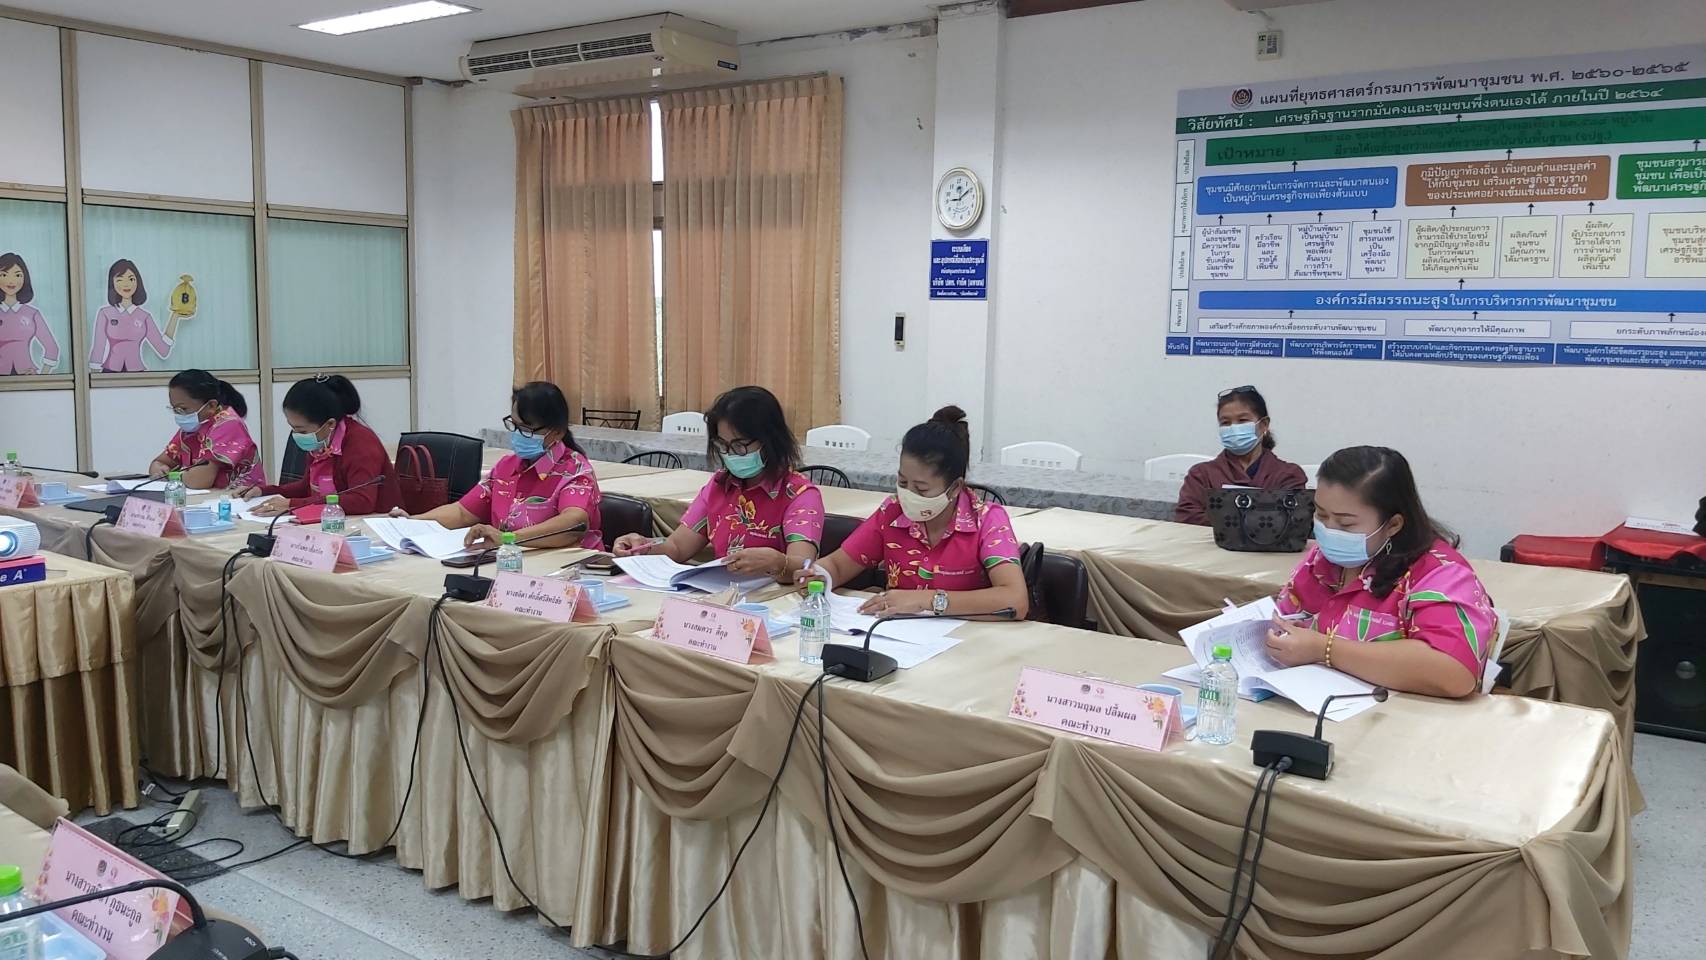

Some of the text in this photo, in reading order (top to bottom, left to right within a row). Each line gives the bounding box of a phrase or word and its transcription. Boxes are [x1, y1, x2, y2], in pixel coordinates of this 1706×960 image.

[1260, 72, 1524, 105] แผนที่ยุทธศาสตร์กรมการพัฒนาชุมชน
[1188, 114, 1245, 131] วิสัยทัศน์
[1552, 88, 1609, 104] ภายในปี
[1047, 695, 1137, 721] นางสาวนฤมล ปลื้มผล
[1060, 718, 1111, 737] คณะทำงาน
[71, 908, 114, 944] คณะทำงาน
